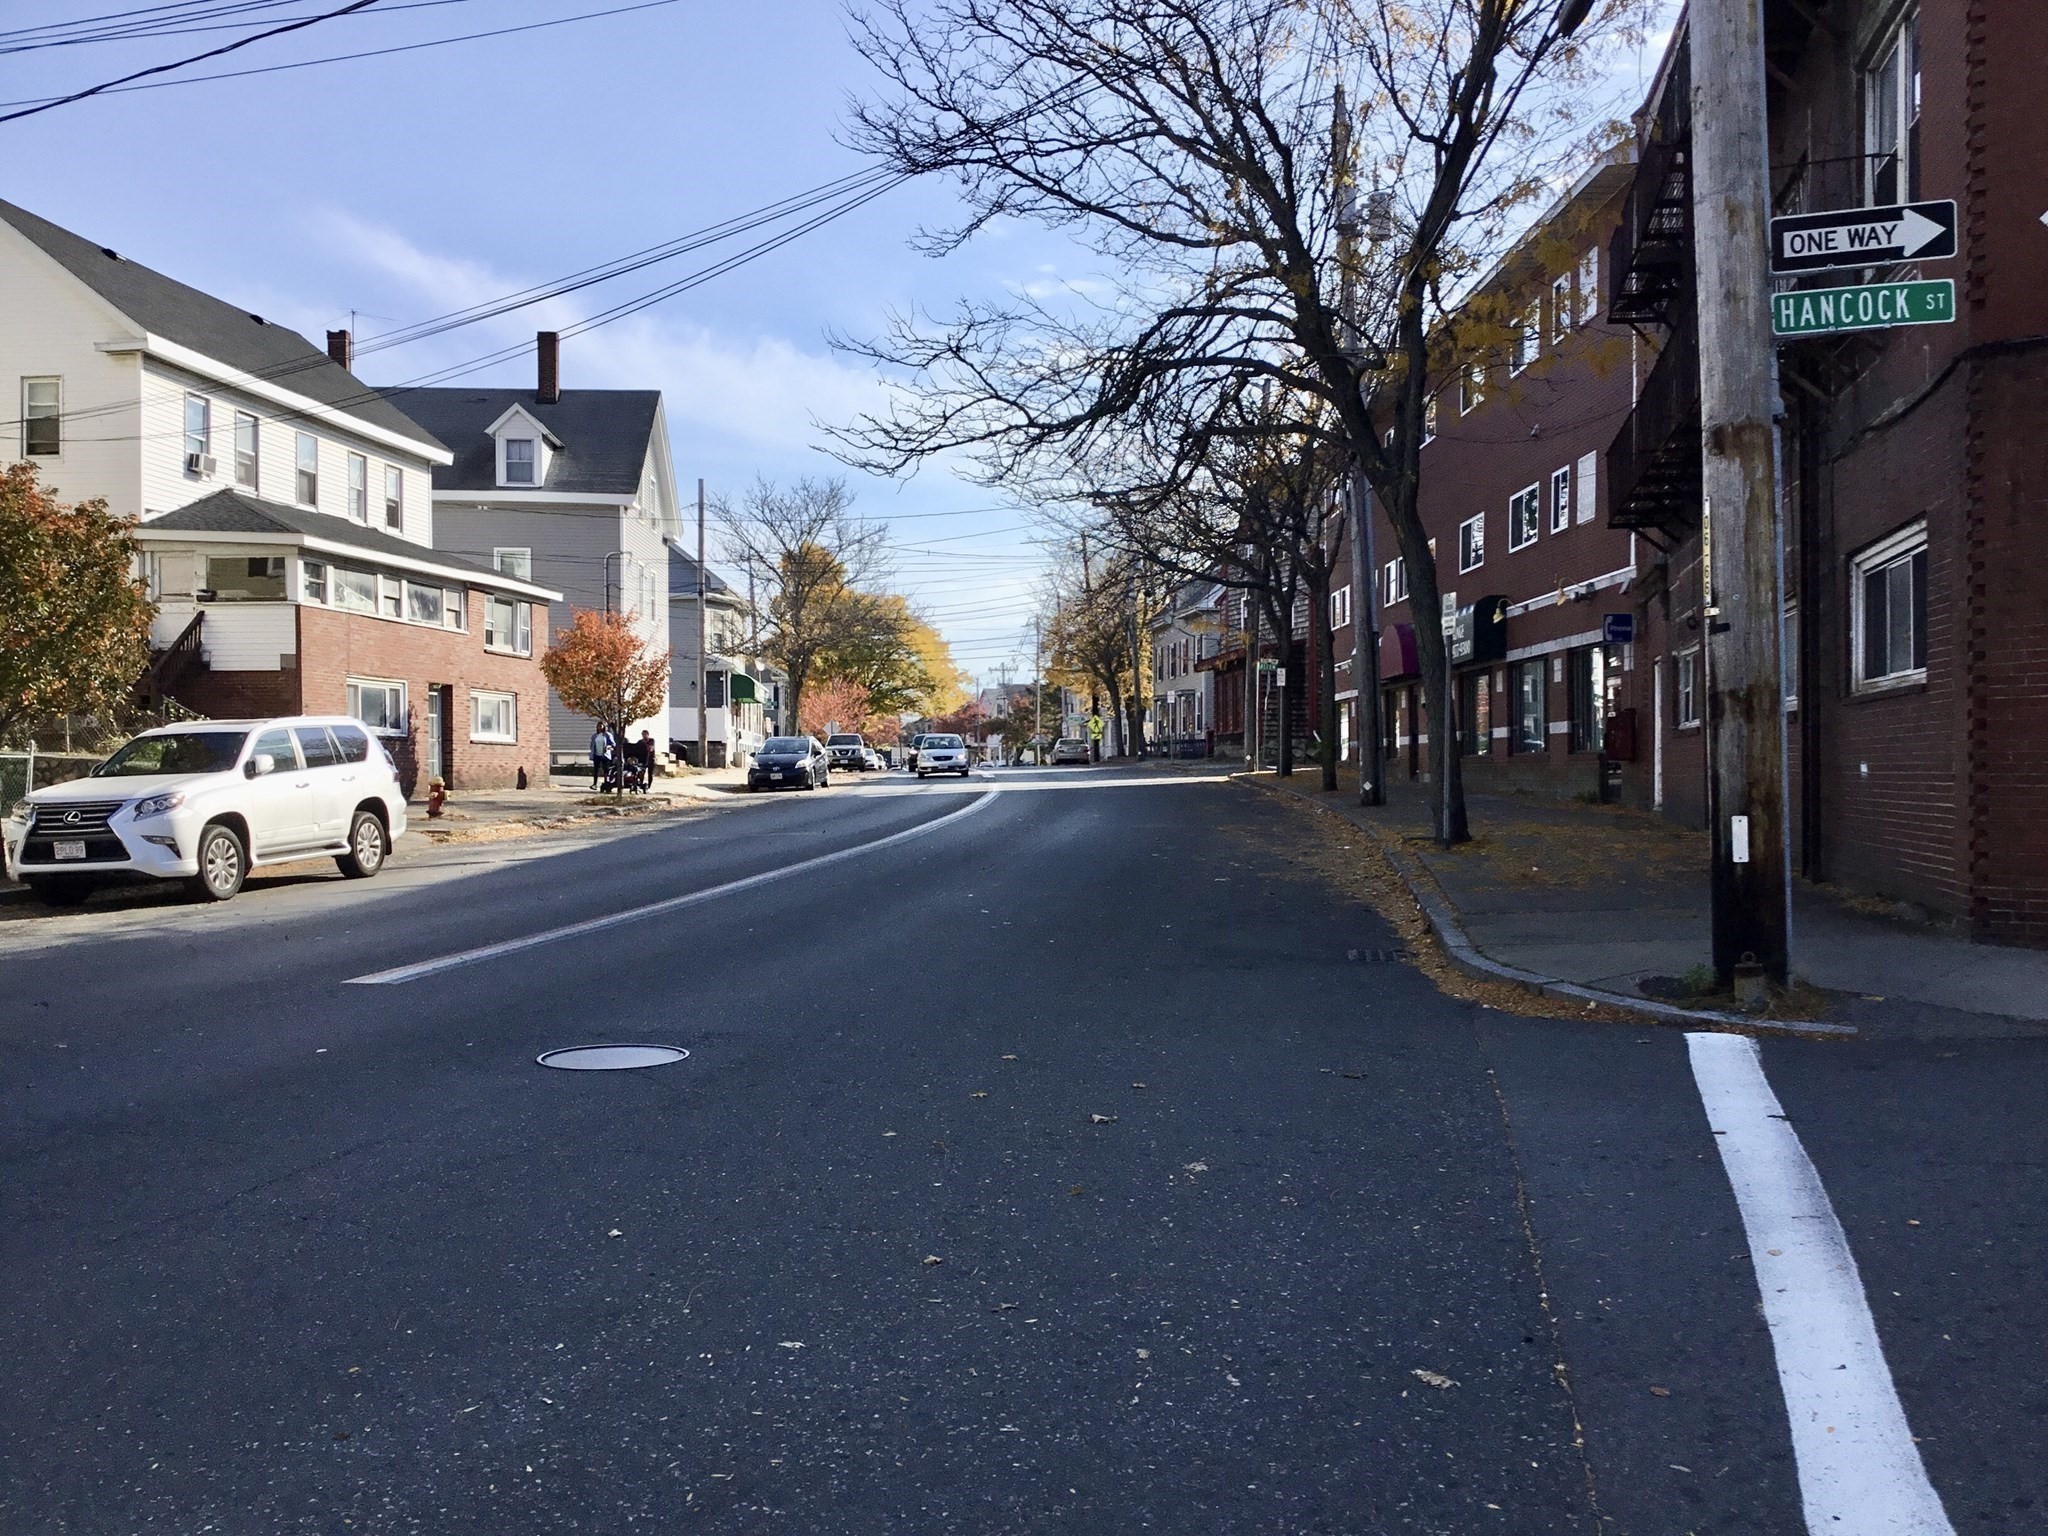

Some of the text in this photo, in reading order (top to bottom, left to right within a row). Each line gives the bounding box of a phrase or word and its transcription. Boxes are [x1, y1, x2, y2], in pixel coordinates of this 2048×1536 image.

[1789, 223, 1899, 255] ONE WAY
[1780, 288, 1945, 328] HANCOCK ST
[1609, 624, 1632, 632] Phone
